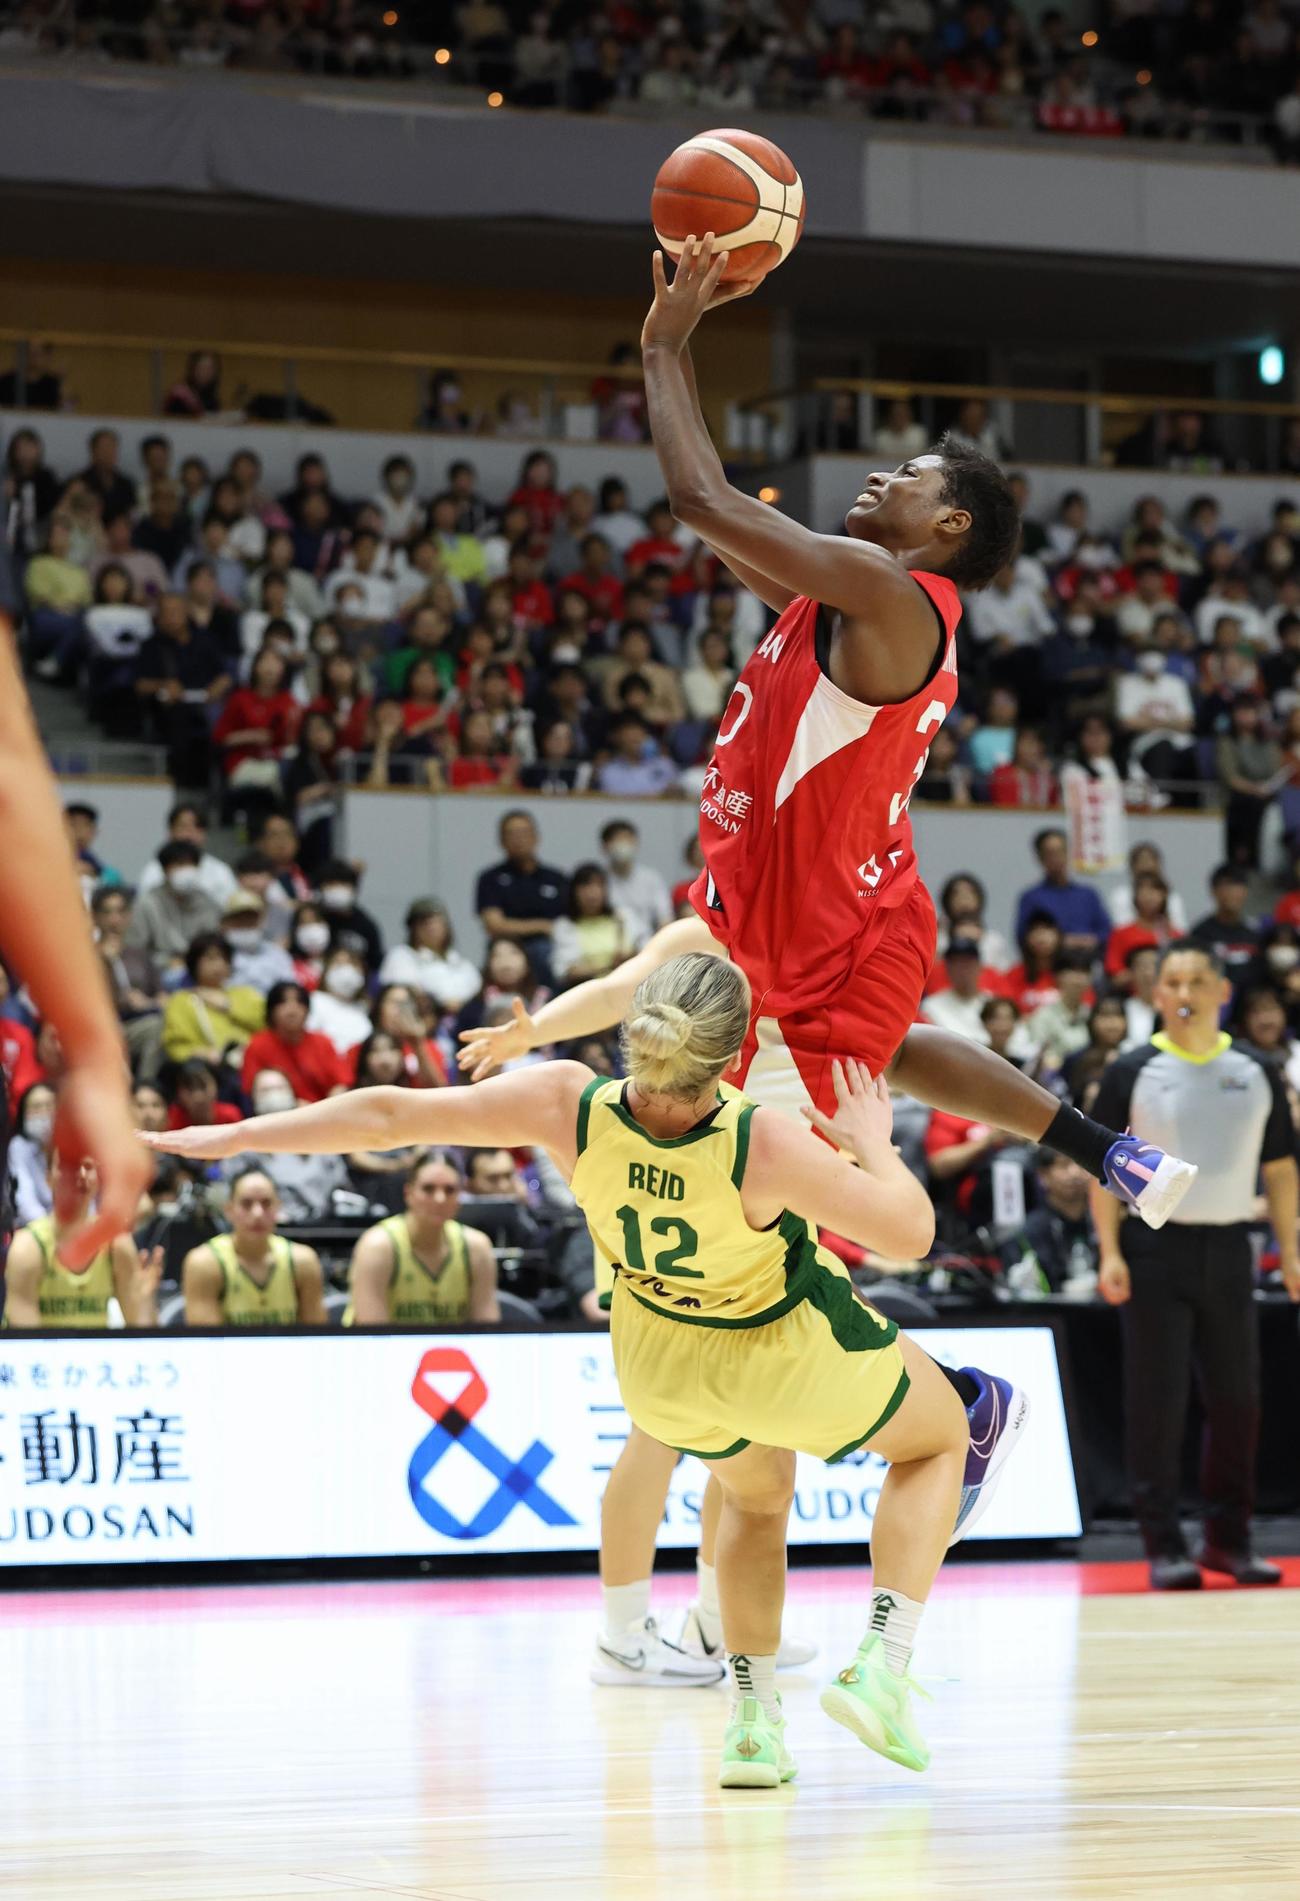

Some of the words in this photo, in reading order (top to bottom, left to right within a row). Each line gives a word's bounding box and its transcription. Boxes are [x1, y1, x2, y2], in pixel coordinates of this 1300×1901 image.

[700, 799, 742, 834] DOSAN
[628, 1162, 685, 1201] REID
[616, 1205, 705, 1279] 12
[0, 1409, 190, 1485] 動産
